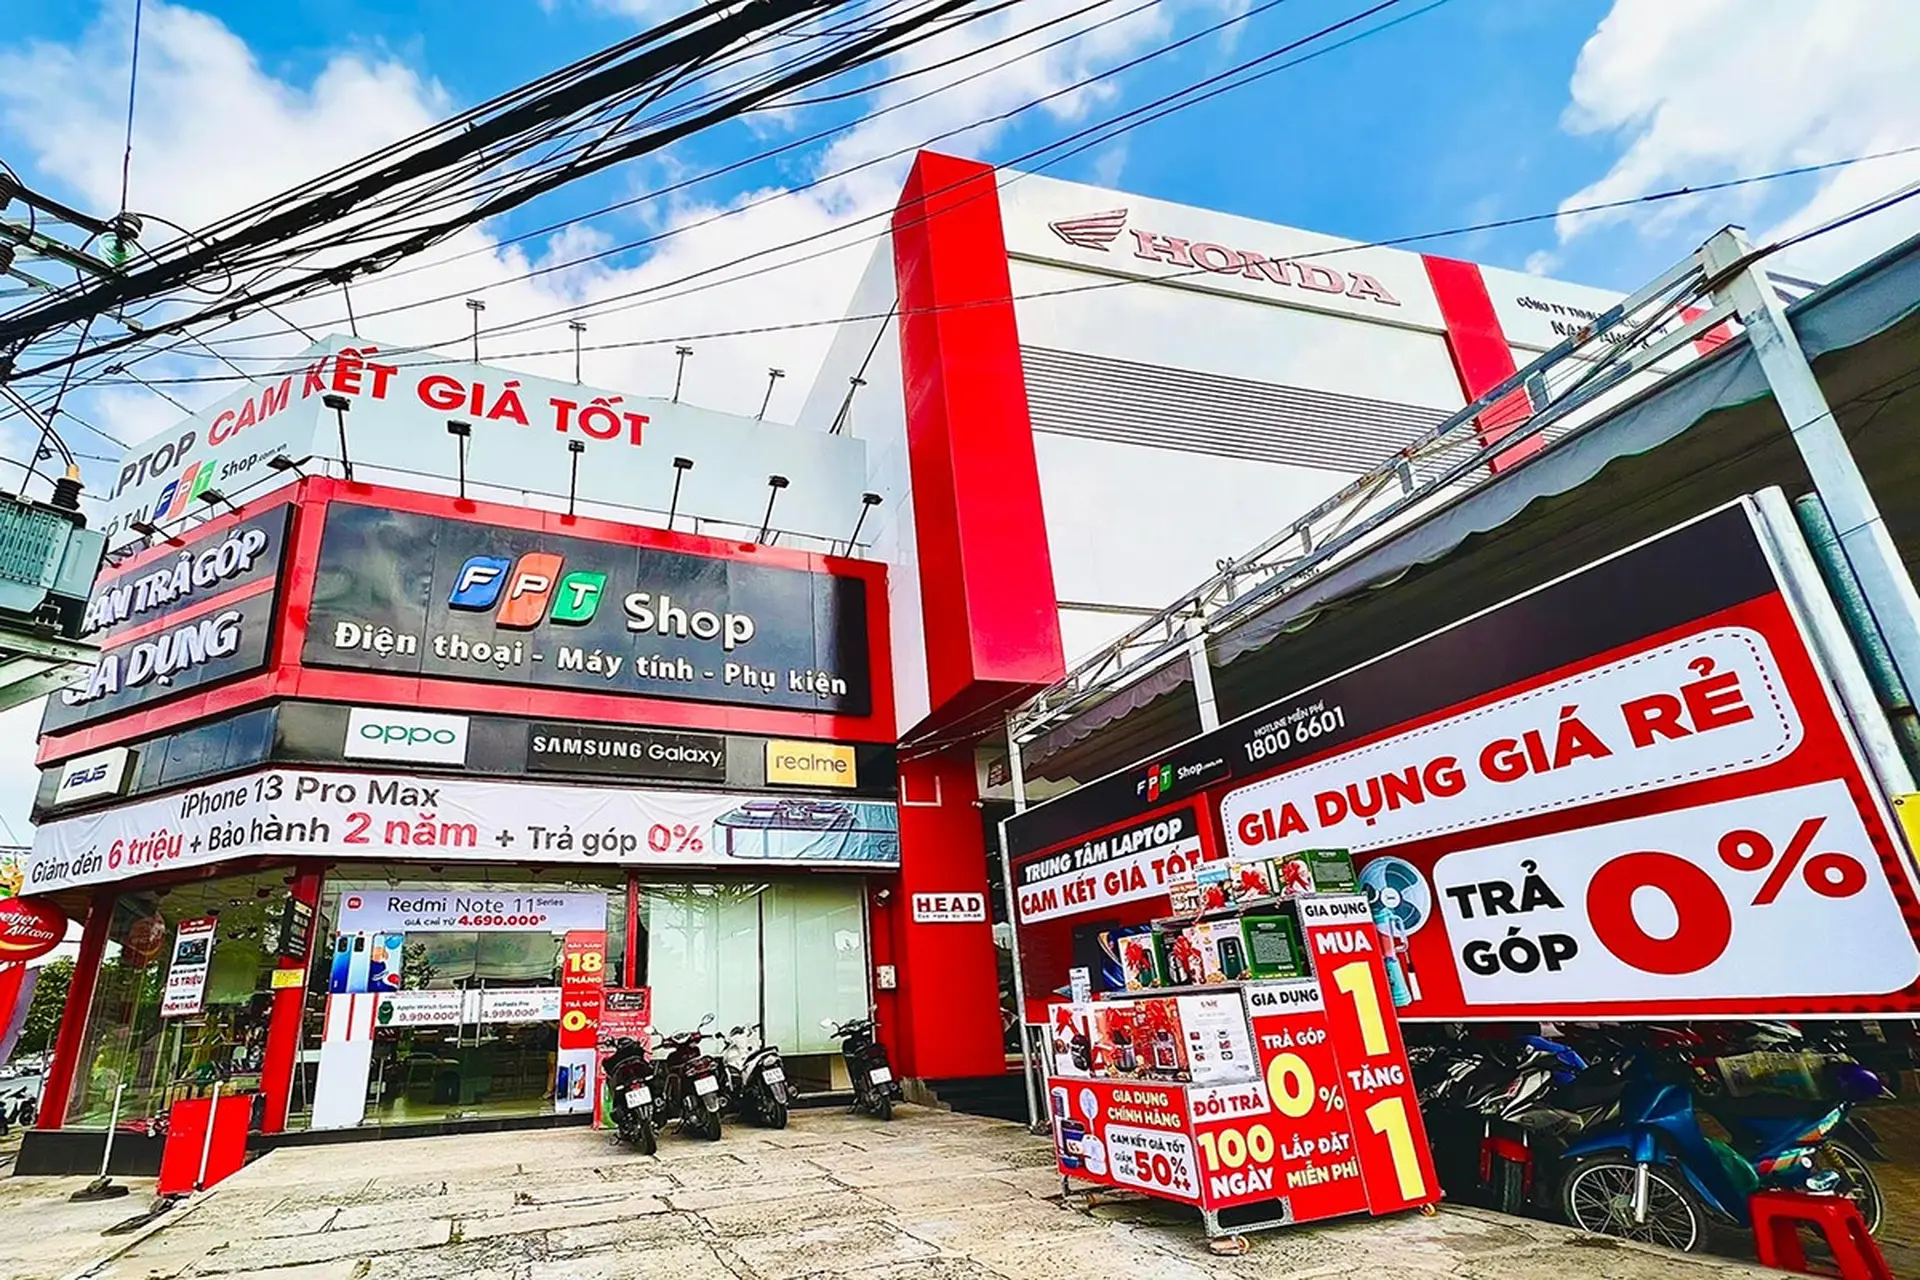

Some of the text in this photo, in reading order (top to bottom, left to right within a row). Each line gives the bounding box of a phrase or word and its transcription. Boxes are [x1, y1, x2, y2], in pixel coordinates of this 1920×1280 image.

[1129, 228, 1402, 307] HONDA
[208, 376, 292, 447] CAM
[302, 347, 399, 400] KẾT
[417, 375, 530, 426] GIÁ
[550, 396, 650, 446] TỐT
[134, 552, 195, 612] TRẢ
[192, 527, 269, 587] GÓP
[457, 562, 756, 651] FPT Shop
[126, 610, 242, 687] DỤNG
[334, 621, 417, 657] Điện
[432, 633, 522, 671] thoại
[557, 645, 623, 678] Máy
[636, 652, 693, 681] tính
[724, 663, 775, 695] Phụ
[788, 668, 848, 699] kiện
[360, 723, 456, 746] oppo
[1244, 705, 1345, 762] 1800 6601
[1253, 716, 1287, 738] HOTLINE
[532, 736, 722, 768] SAMSUNG Galaxy
[775, 753, 847, 774] realme
[1237, 656, 1755, 847] GIA DỤNG GIÁ RẺ
[62, 763, 108, 789] ASUS
[1135, 768, 1171, 797] FPT
[181, 774, 440, 820] iPhone 13 Pro Max
[31, 855, 68, 884] Giảm
[71, 844, 102, 876] đến
[107, 838, 122, 870] 6
[125, 827, 183, 871] triệu
[208, 824, 245, 853] Bảo
[250, 815, 330, 845] hành
[343, 812, 370, 844] 2
[384, 813, 477, 848] năm
[527, 824, 574, 851] Trả
[582, 827, 637, 857] góp
[646, 823, 704, 853] 0%
[1025, 817, 1183, 884] TRUNG TÂM LAPTOP
[1021, 887, 1057, 916] CAM
[1063, 869, 1096, 906] KẾT
[1103, 860, 1147, 899] GIÁ
[1151, 844, 1200, 885] TỐT
[1446, 859, 1565, 920] TRẢ
[387, 897, 564, 914] Redmi Note 11 Series
[916, 897, 981, 913] HEAD
[1304, 900, 1368, 921] GIA DỤNG
[1586, 816, 1868, 976] 0%
[404, 917, 421, 927] GIÁ
[1314, 929, 1373, 955] MUA
[1461, 926, 1579, 976] GÓP
[567, 951, 603, 973] 18
[566, 975, 602, 984] THÁNG
[1251, 988, 1319, 1008] GIA DỤNG
[1331, 961, 1390, 1058] 1
[562, 1009, 599, 1032] 0%
[1261, 1028, 1327, 1048] TRẢ GÓP
[1266, 1052, 1345, 1119] 0%
[1347, 1065, 1404, 1094] TẶNG
[1107, 1104, 1143, 1123] CHÍNH
[1112, 1089, 1169, 1109] GIA DỤNG
[1193, 1086, 1264, 1117] ĐỔI TRẢ
[1110, 1133, 1186, 1154] CAM KẾT GIÁ TỐT
[1197, 1123, 1275, 1172] 100
[1281, 1131, 1350, 1161] LẮP ĐẶT
[1364, 1096, 1428, 1202] 1
[1134, 1150, 1188, 1187] 50%
[1210, 1165, 1273, 1199] NGÀY
[1286, 1158, 1358, 1189] MIỄN PHÍ
